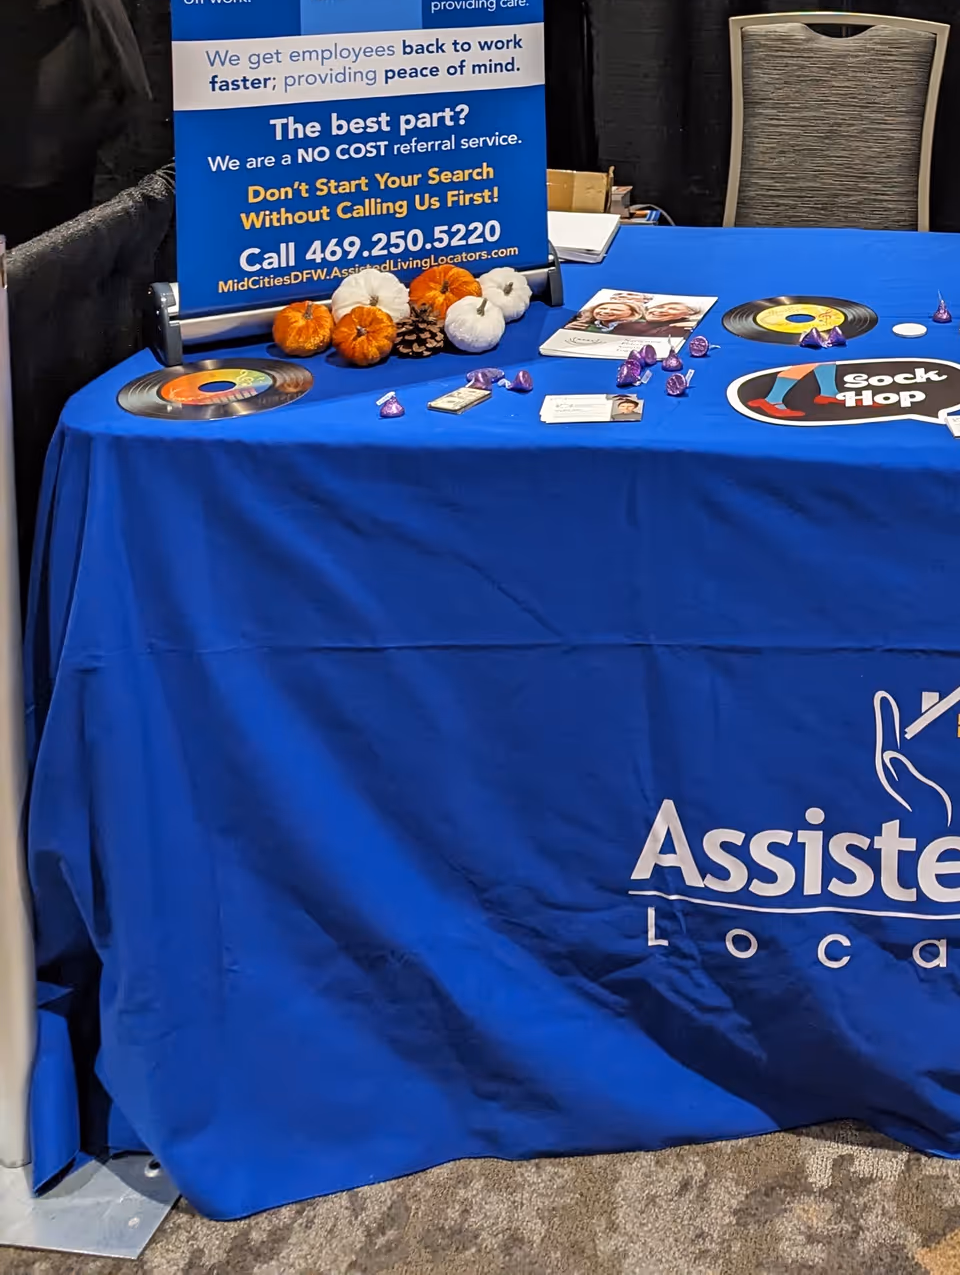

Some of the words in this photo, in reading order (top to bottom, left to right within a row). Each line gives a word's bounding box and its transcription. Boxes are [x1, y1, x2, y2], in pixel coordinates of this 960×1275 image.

[206, 50, 241, 67] We
[248, 49, 282, 69] get
[289, 44, 395, 64] employees
[402, 39, 446, 55] back
[478, 34, 523, 51] work
[209, 73, 277, 93] faster;
[285, 67, 377, 90] providing
[384, 64, 440, 83] peace
[472, 58, 520, 75] mind.
[269, 116, 322, 141] The
[331, 112, 390, 136] best
[400, 104, 469, 135] part?
[208, 154, 240, 172] We
[246, 154, 276, 169] are
[298, 146, 330, 164] NO
[336, 140, 389, 160] COST
[393, 136, 455, 155] referral
[460, 131, 522, 150] service.
[248, 180, 309, 203] Don’t
[316, 175, 368, 197] Start
[375, 170, 419, 190] Your
[428, 162, 494, 184] Search
[240, 205, 330, 229] Without
[337, 198, 408, 219] Calling
[415, 194, 440, 211] Us
[447, 187, 499, 208] First!
[240, 242, 295, 272] Call
[306, 220, 501, 263] 469.250.5220
[843, 367, 948, 388] Sock
[835, 390, 927, 409] Hop
